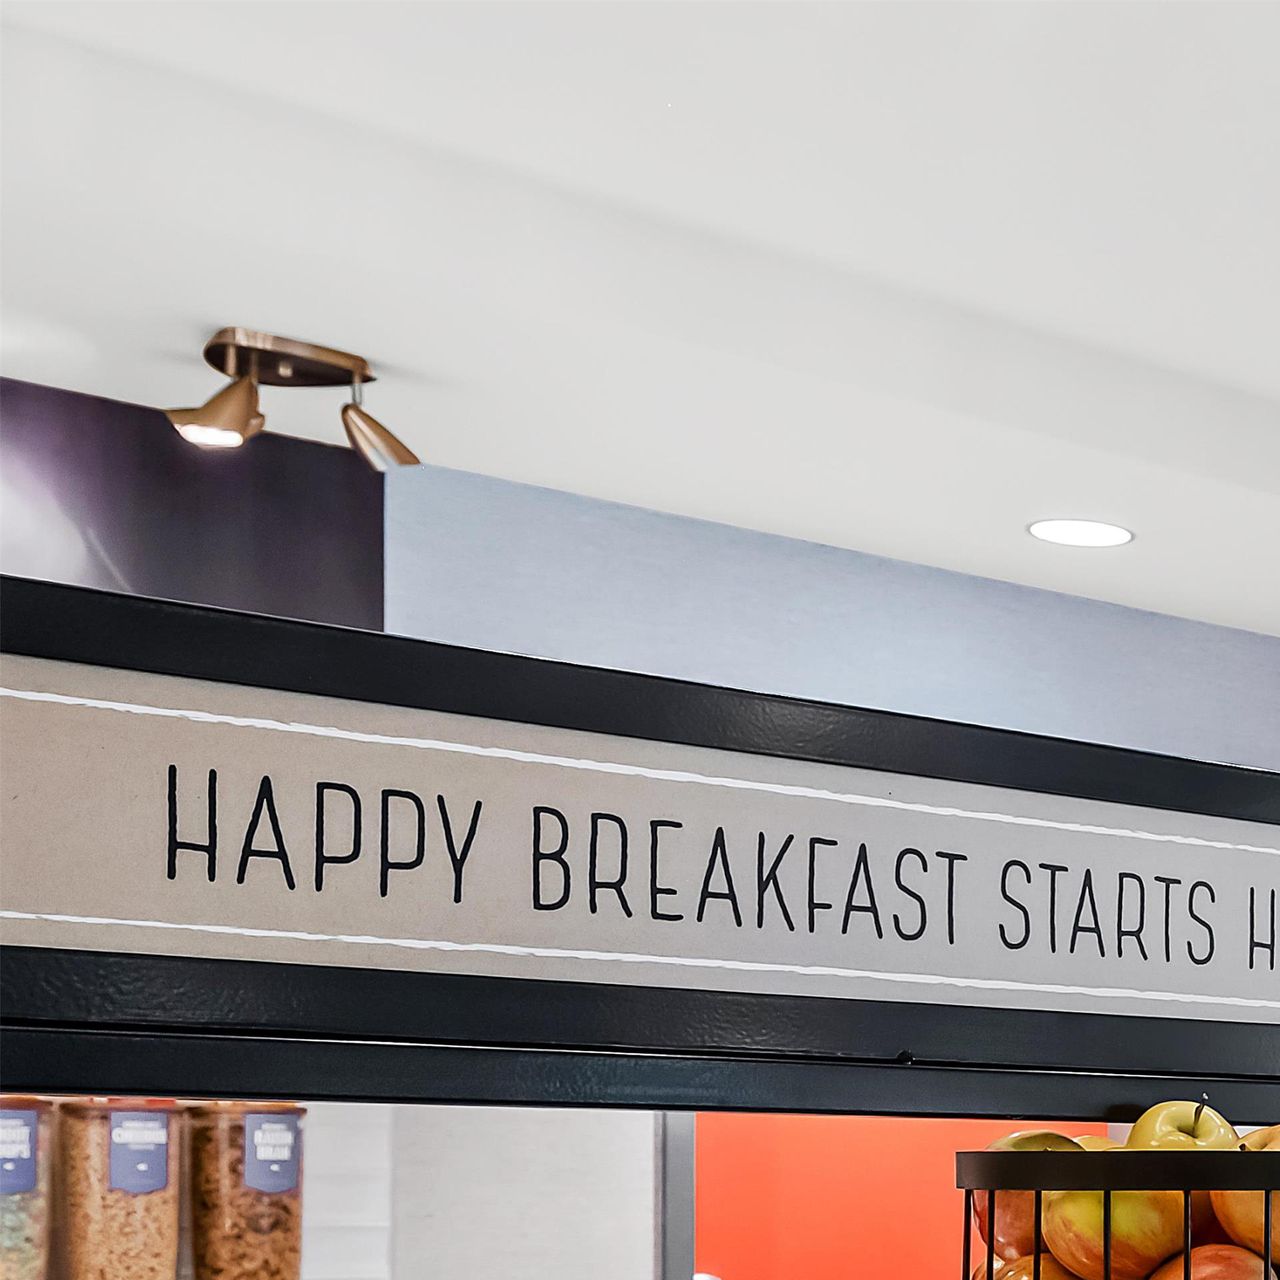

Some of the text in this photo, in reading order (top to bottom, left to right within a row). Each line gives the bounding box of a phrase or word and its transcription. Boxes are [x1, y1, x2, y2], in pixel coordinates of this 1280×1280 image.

[167, 764, 483, 904] HAPPY
[531, 806, 968, 945] BREAKFAST
[999, 858, 1216, 966] STARTS
